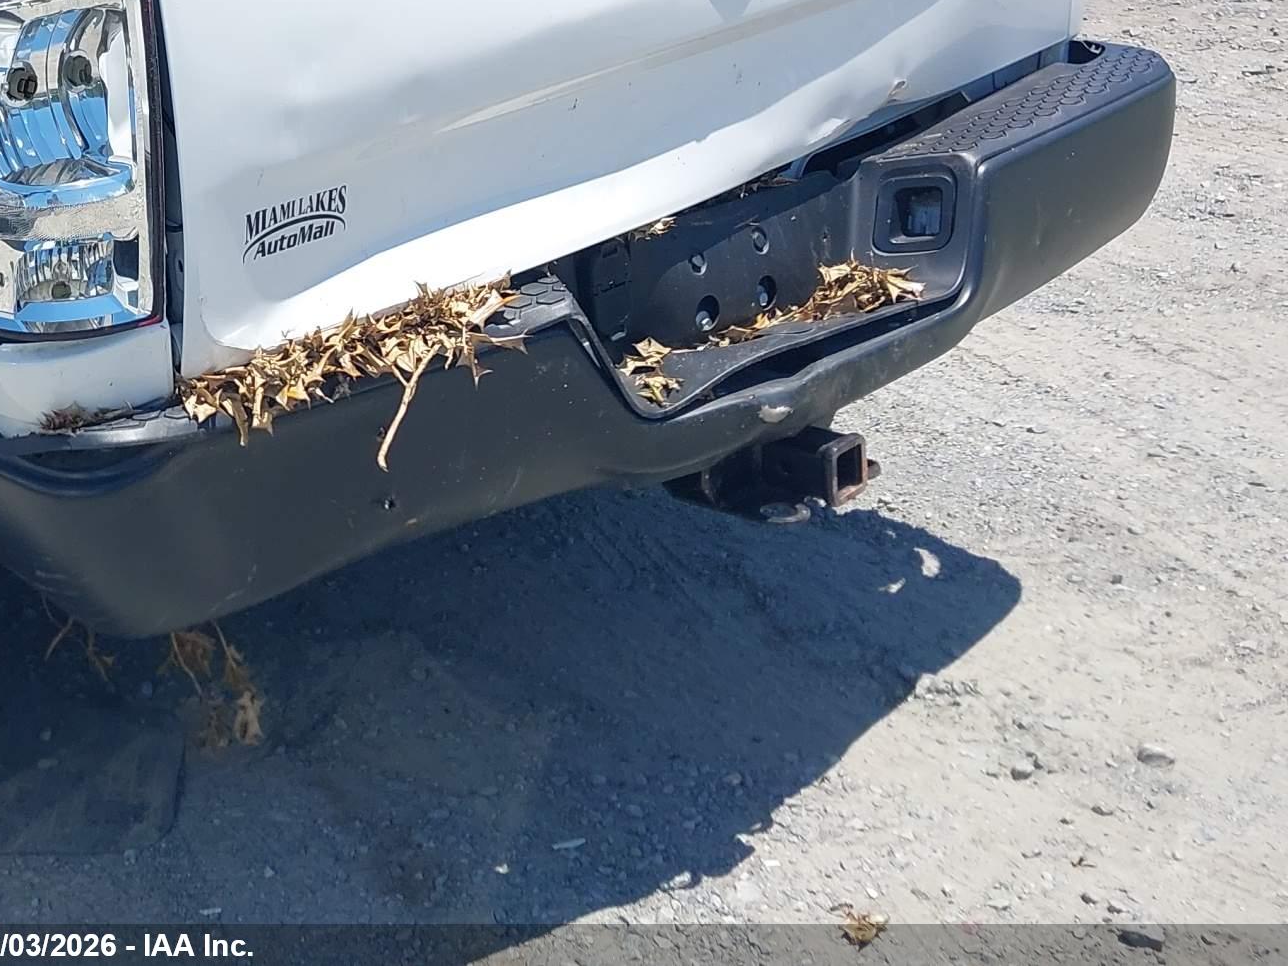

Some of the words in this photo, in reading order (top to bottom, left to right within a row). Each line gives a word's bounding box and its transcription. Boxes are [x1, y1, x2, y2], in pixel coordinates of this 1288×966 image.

[244, 199, 297, 245] MIAMI
[298, 184, 347, 215] LAKES
[253, 220, 336, 261] AutoMall
